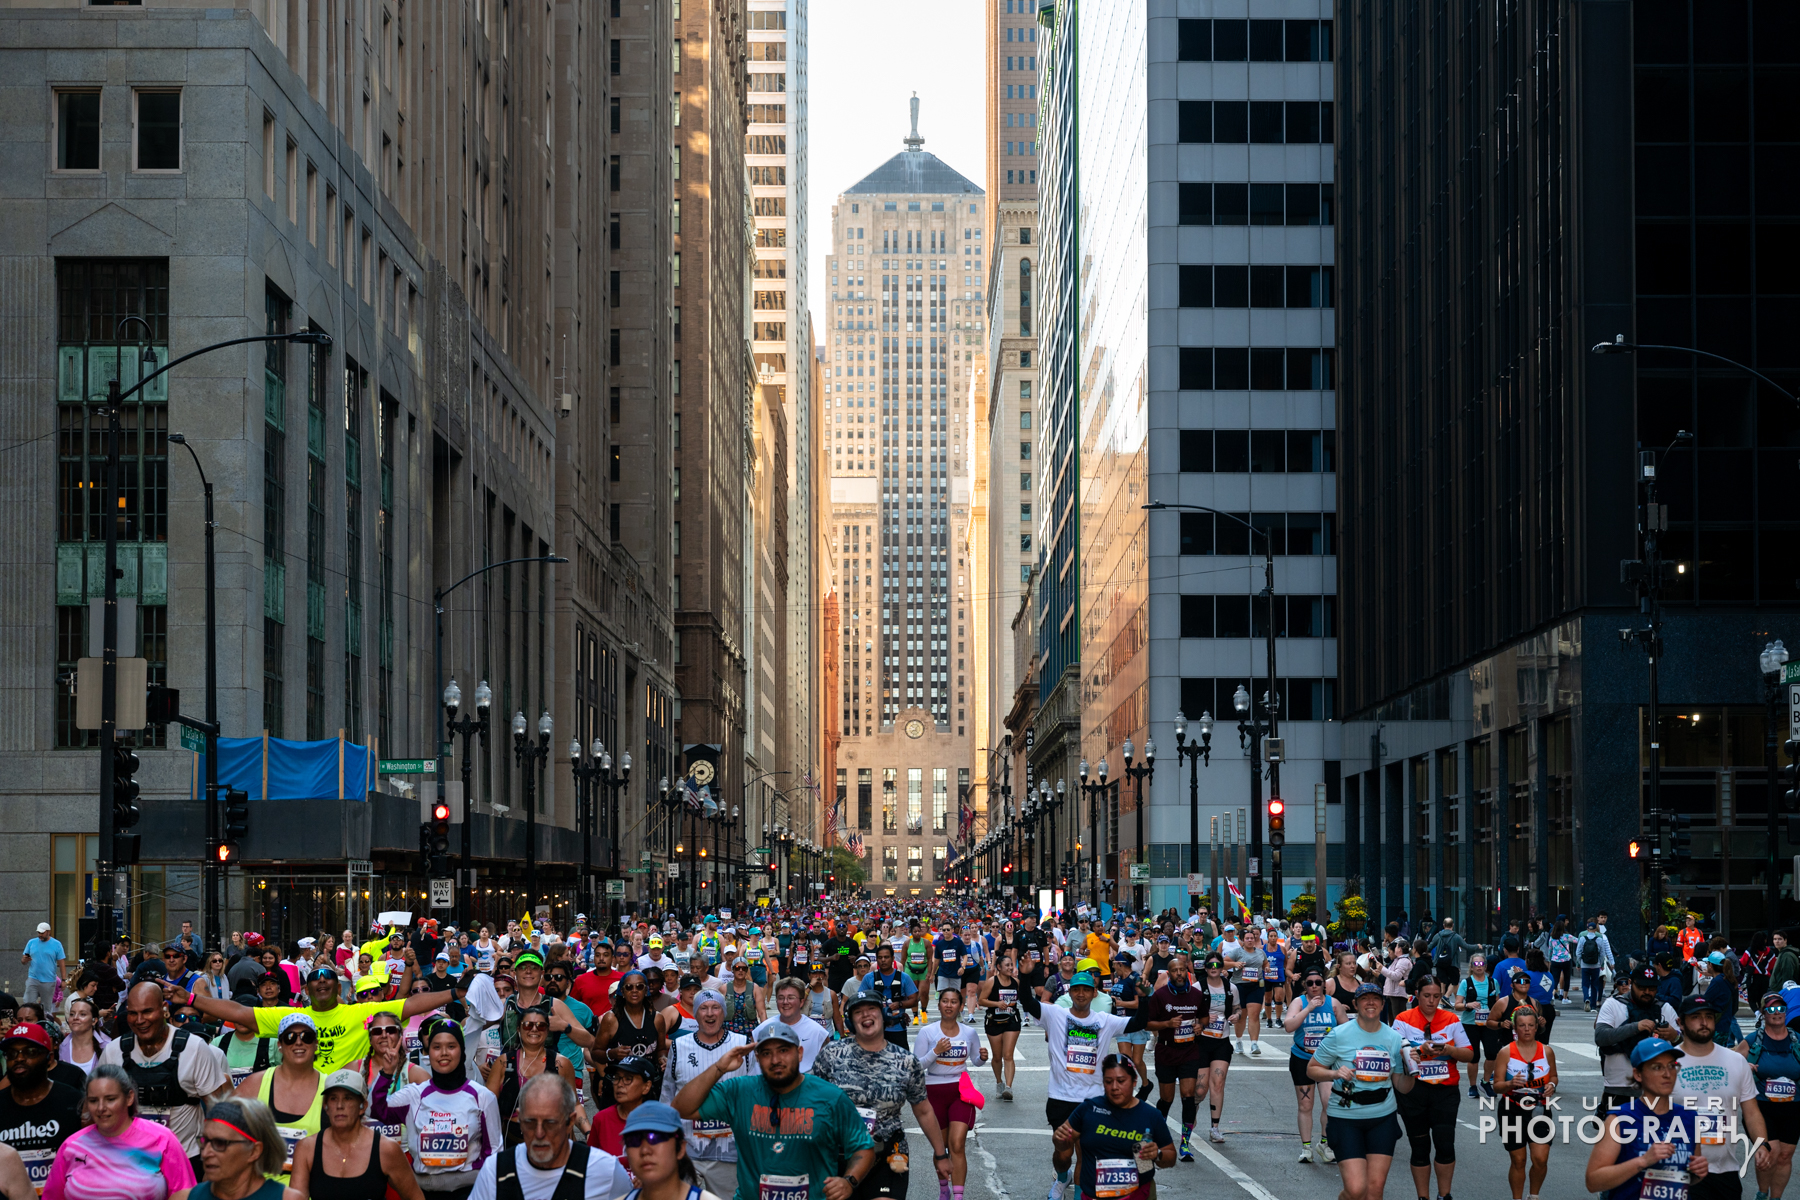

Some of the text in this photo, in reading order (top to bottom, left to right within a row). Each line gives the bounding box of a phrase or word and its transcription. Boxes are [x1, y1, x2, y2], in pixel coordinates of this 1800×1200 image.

[386, 762, 416, 772] Washington
[1688, 936, 1700, 949] 54
[1069, 1030, 1096, 1041] Chicago
[1075, 1054, 1096, 1064] 58873
[1365, 1061, 1390, 1070] 70718
[1425, 1066, 1448, 1074] 71760
[1681, 1069, 1724, 1078] CHICAGO
[1773, 1085, 1795, 1093] 63105
[703, 1120, 730, 1128] 5514
[750, 1104, 814, 1135] DOLHINS
[1096, 1124, 1143, 1142] Brenda
[423, 1139, 467, 1150] N 67750
[1106, 1173, 1137, 1183] 73536
[762, 1191, 808, 1200] N 71662
[1643, 1185, 1687, 1200] N 63146
